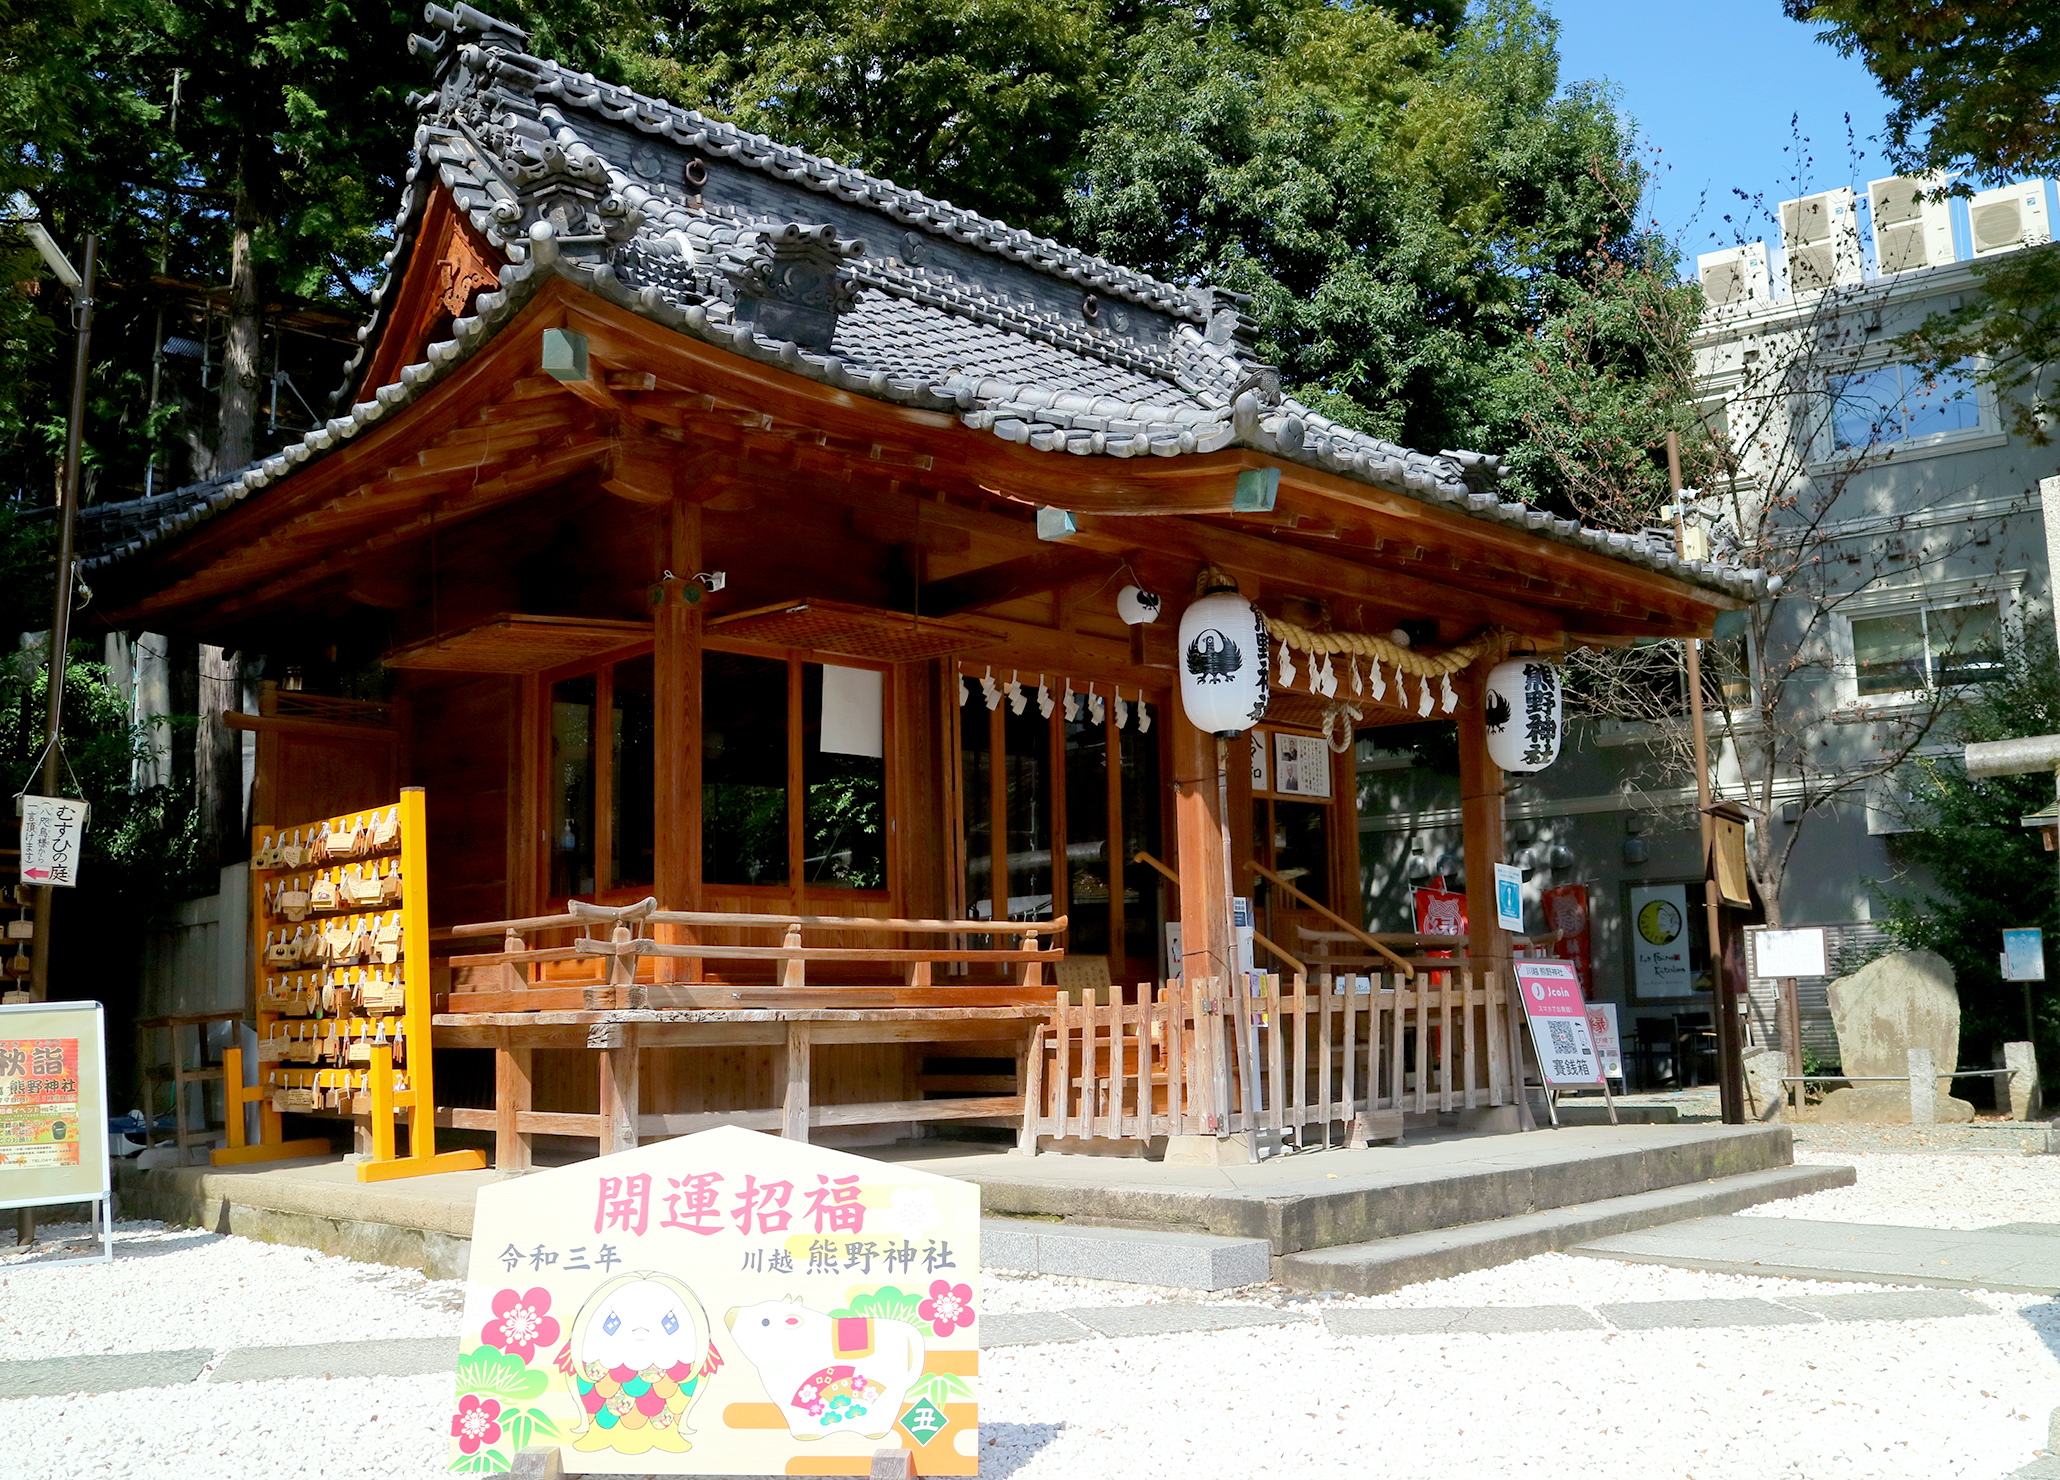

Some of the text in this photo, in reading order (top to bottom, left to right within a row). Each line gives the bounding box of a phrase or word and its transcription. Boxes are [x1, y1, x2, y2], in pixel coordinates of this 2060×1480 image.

[1521, 662, 1557, 765] 熊野神社
[49, 805, 76, 882] むすひの庭
[1540, 968, 1564, 977] 熊野神社
[1547, 986, 1570, 997] Jcoin
[0, 1047, 64, 1076] 秋詣
[1552, 1059, 1590, 1075] 賽銭箱
[10, 1078, 76, 1095] 熊野神社
[594, 1172, 867, 1236] 開運招福
[497, 1239, 958, 1275] 令和三年 川越 熊野神社
[912, 1407, 939, 1432] 丑
